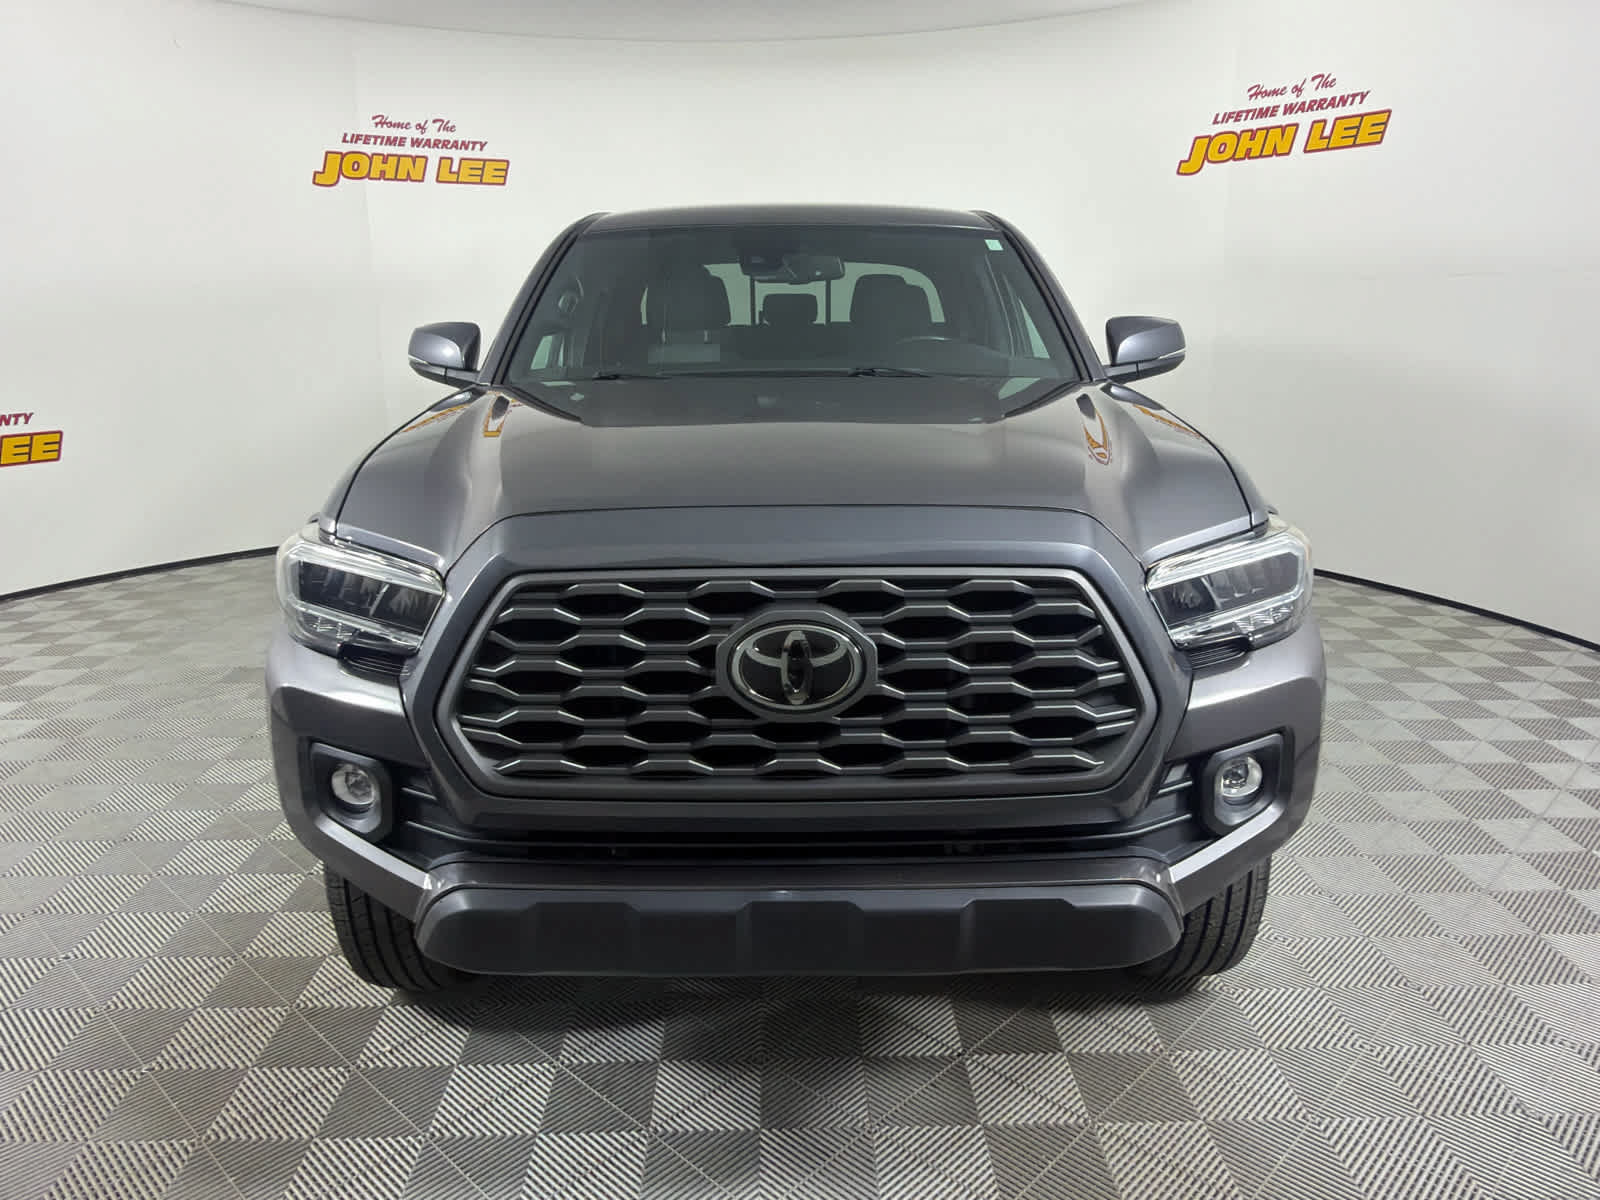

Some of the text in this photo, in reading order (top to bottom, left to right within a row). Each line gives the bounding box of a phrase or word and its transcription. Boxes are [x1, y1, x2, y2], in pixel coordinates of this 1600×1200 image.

[1247, 73, 1337, 101] Home of The
[1212, 90, 1370, 125] LIFETIME WARRANTY
[371, 114, 456, 135] Home of The
[341, 132, 488, 151] LIFETIME WARRANTY
[1176, 109, 1392, 176] JOHN LEE
[312, 150, 510, 187] JOHN LEE
